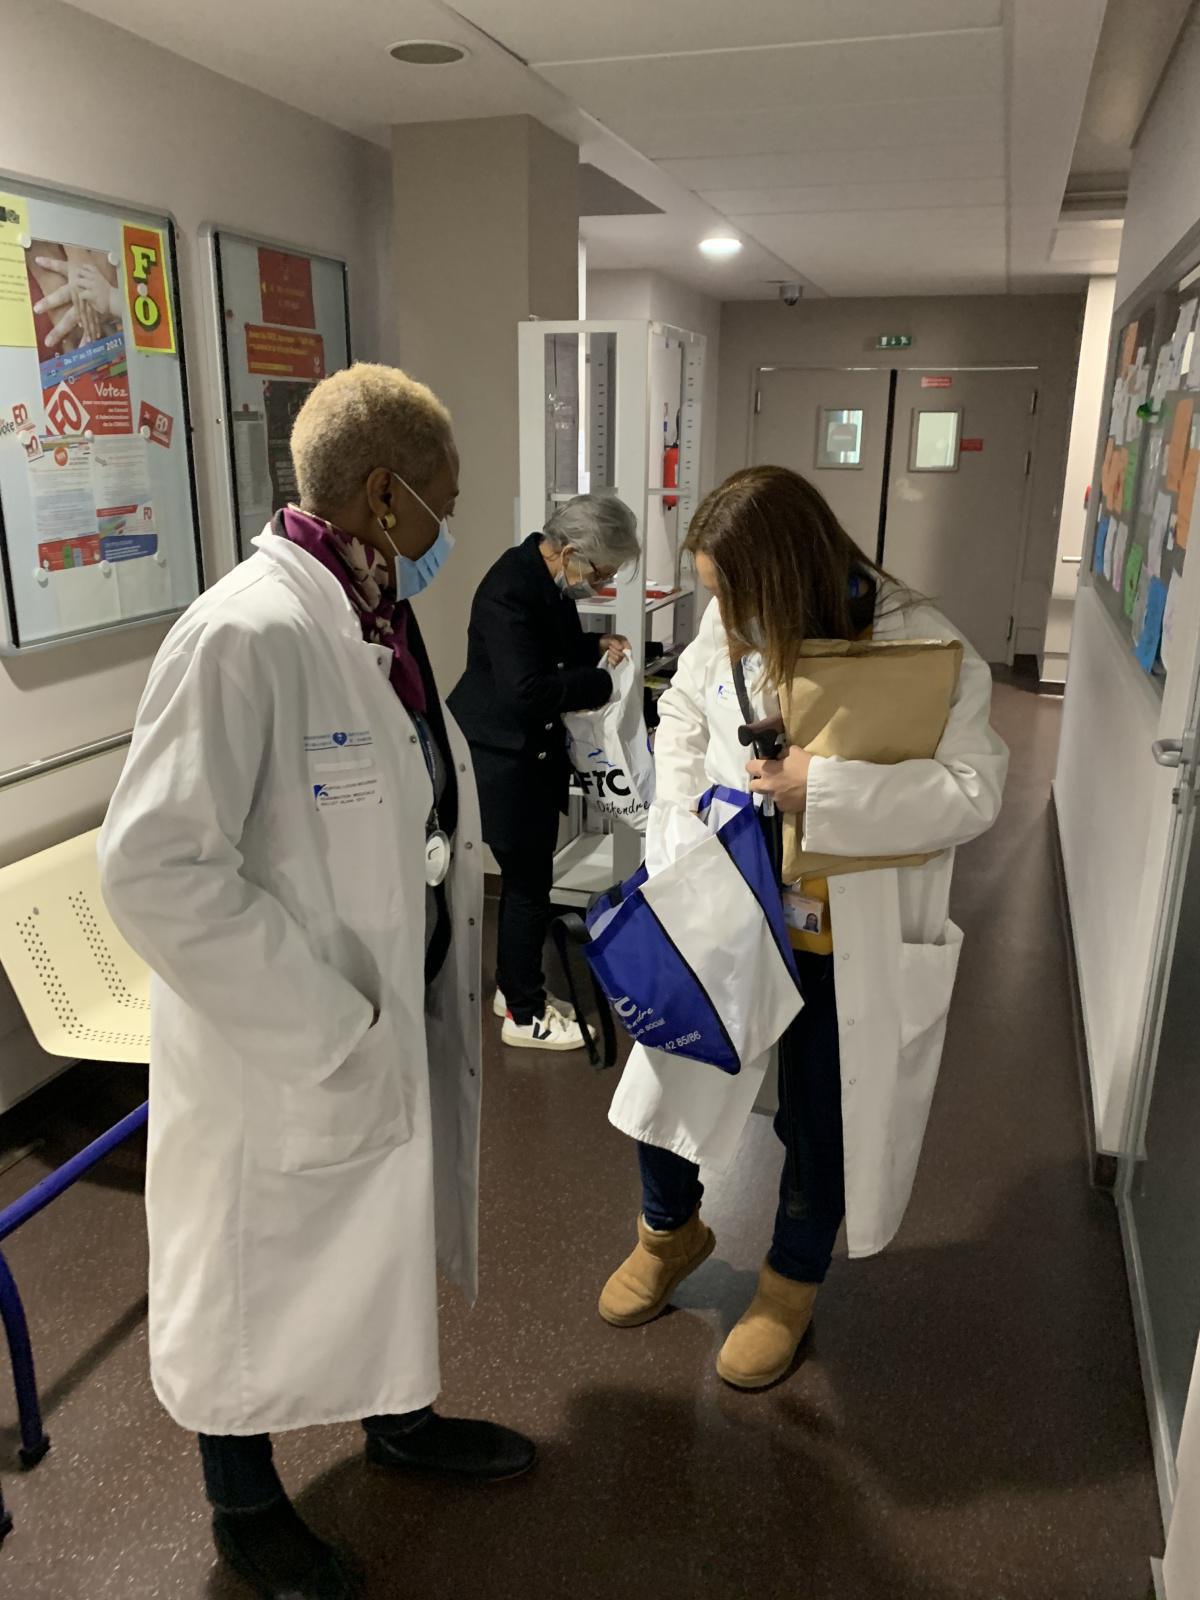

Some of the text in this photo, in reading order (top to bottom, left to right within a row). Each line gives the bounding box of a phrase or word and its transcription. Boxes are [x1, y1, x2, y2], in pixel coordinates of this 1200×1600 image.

[106, 338, 122, 351] 2021
[94, 382, 128, 397] Votez
[48, 390, 82, 436] FO
